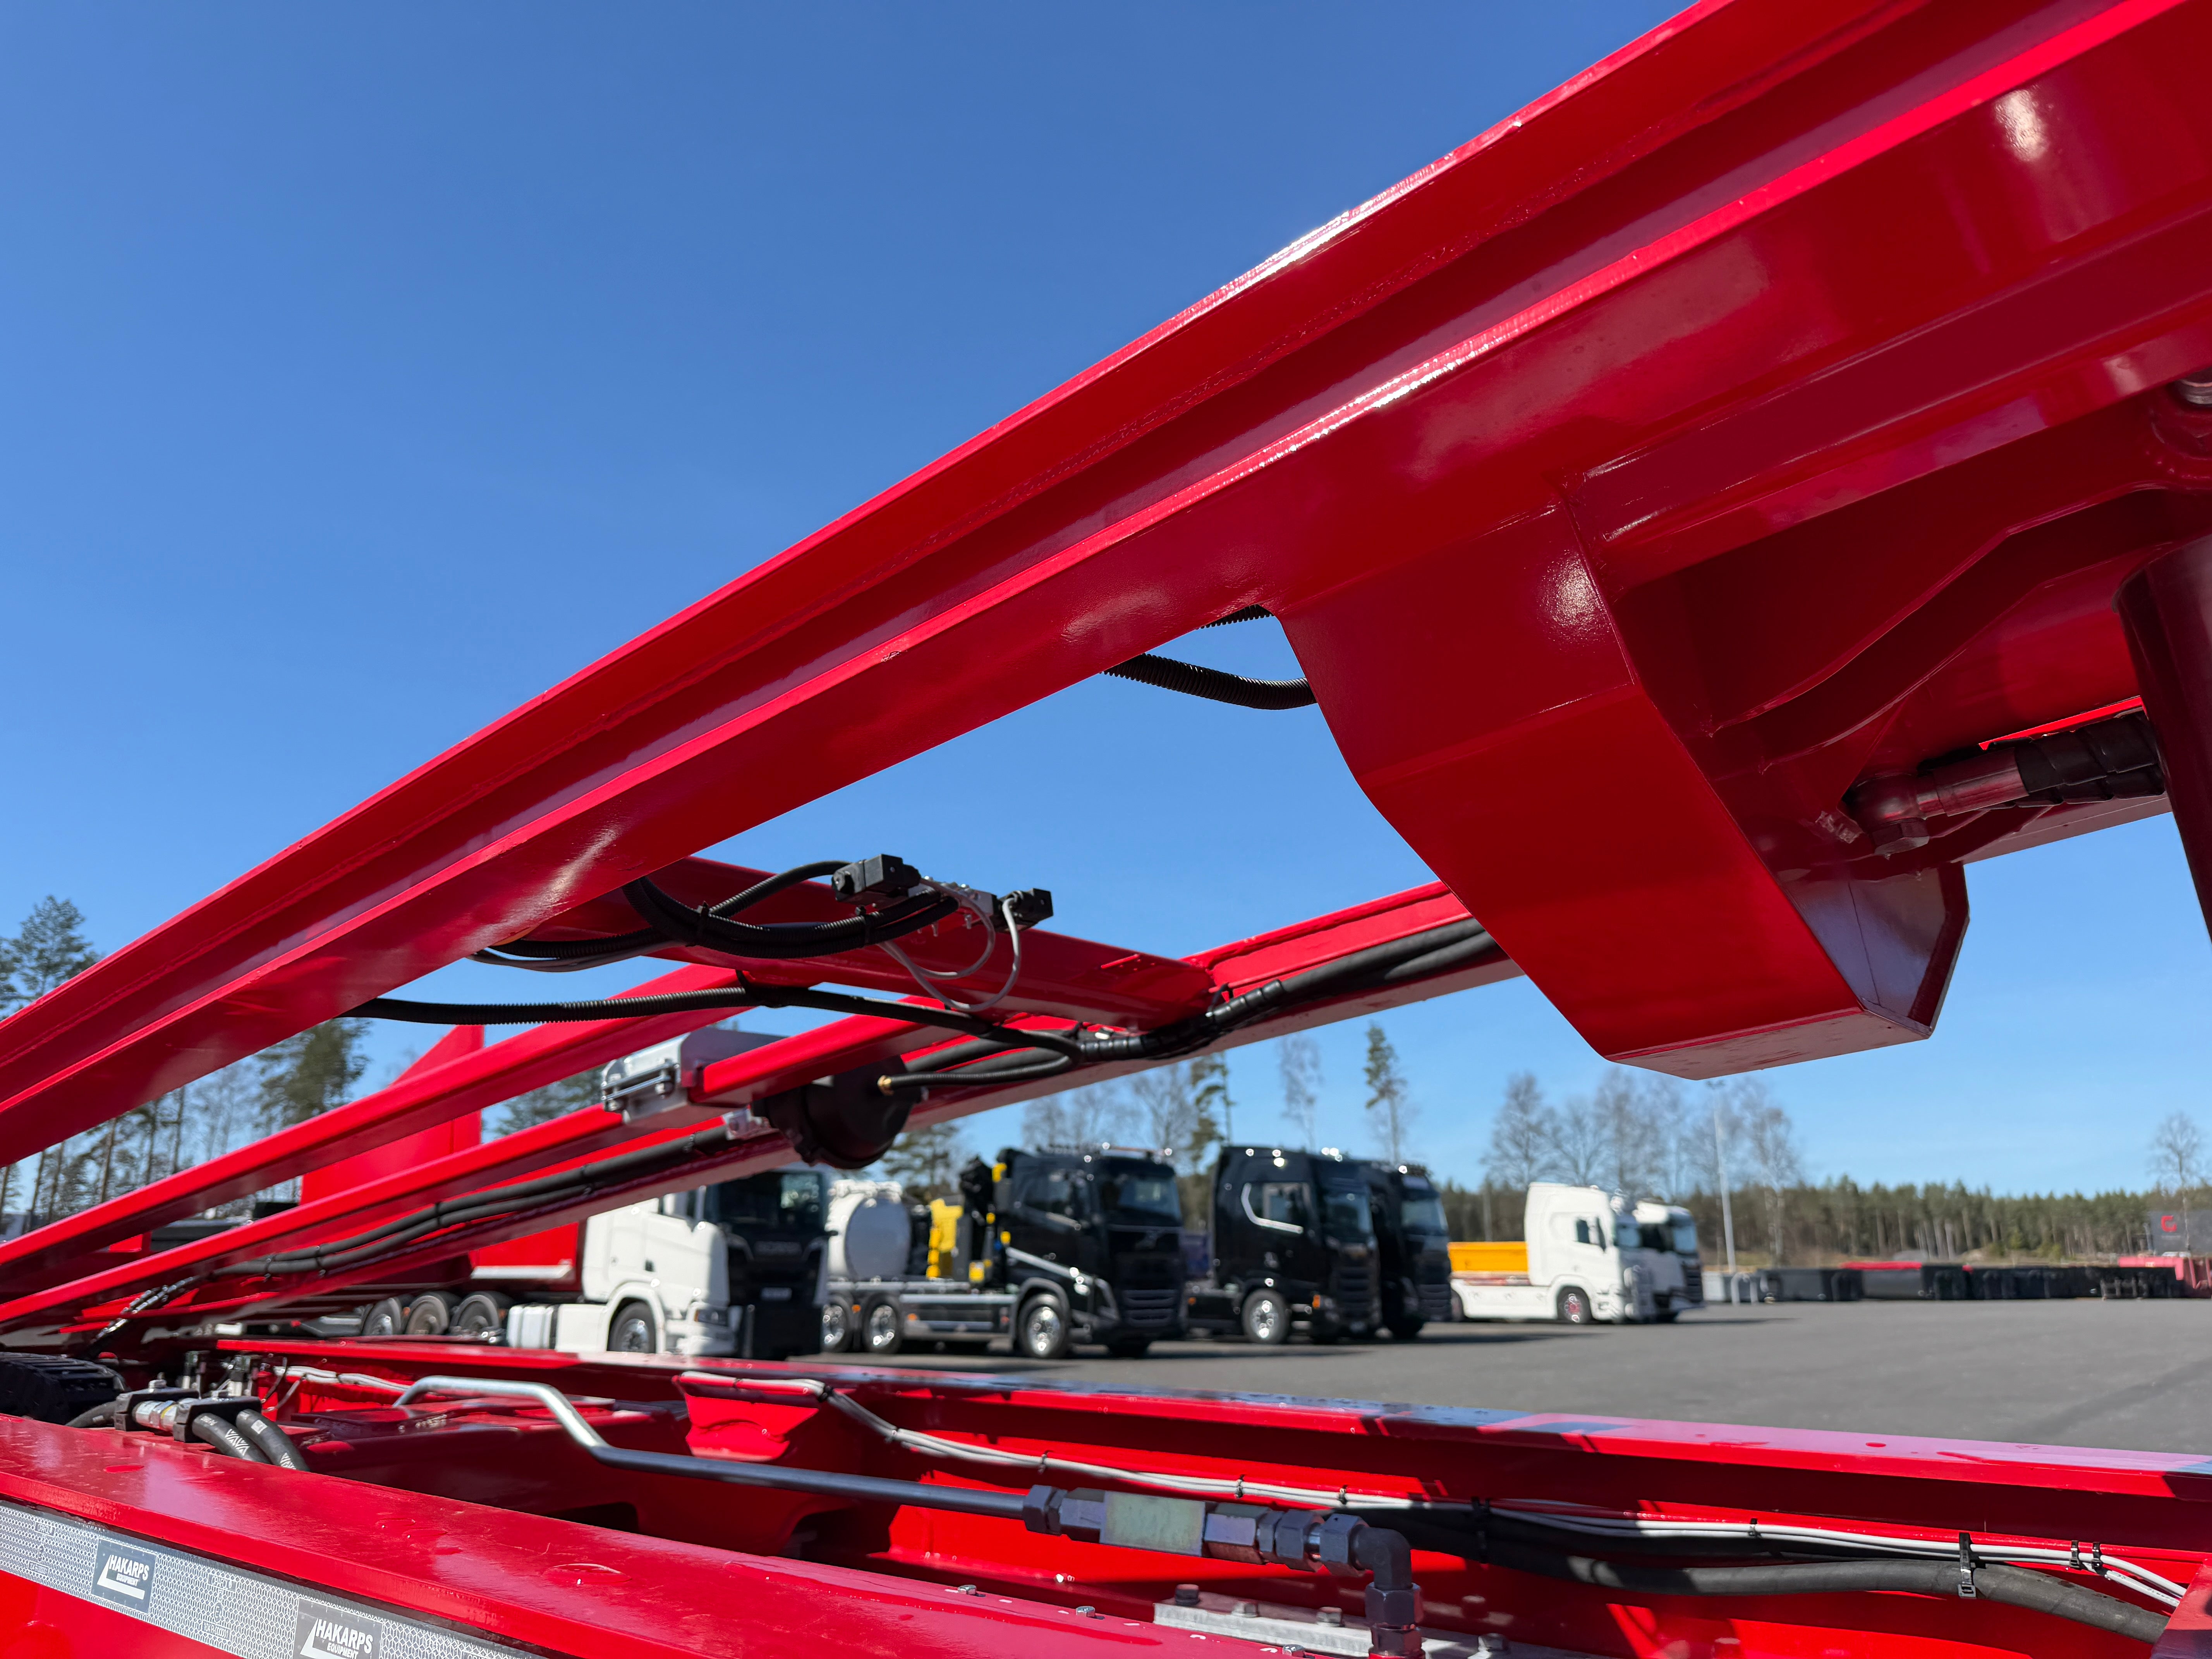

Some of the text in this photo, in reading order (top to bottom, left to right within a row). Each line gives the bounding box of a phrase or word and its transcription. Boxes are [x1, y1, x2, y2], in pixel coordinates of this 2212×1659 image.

[109, 1555, 149, 1581] HAKARPS
[316, 1619, 373, 1654] HAKARPS
[327, 1642, 359, 1659] EQUIPMENT
